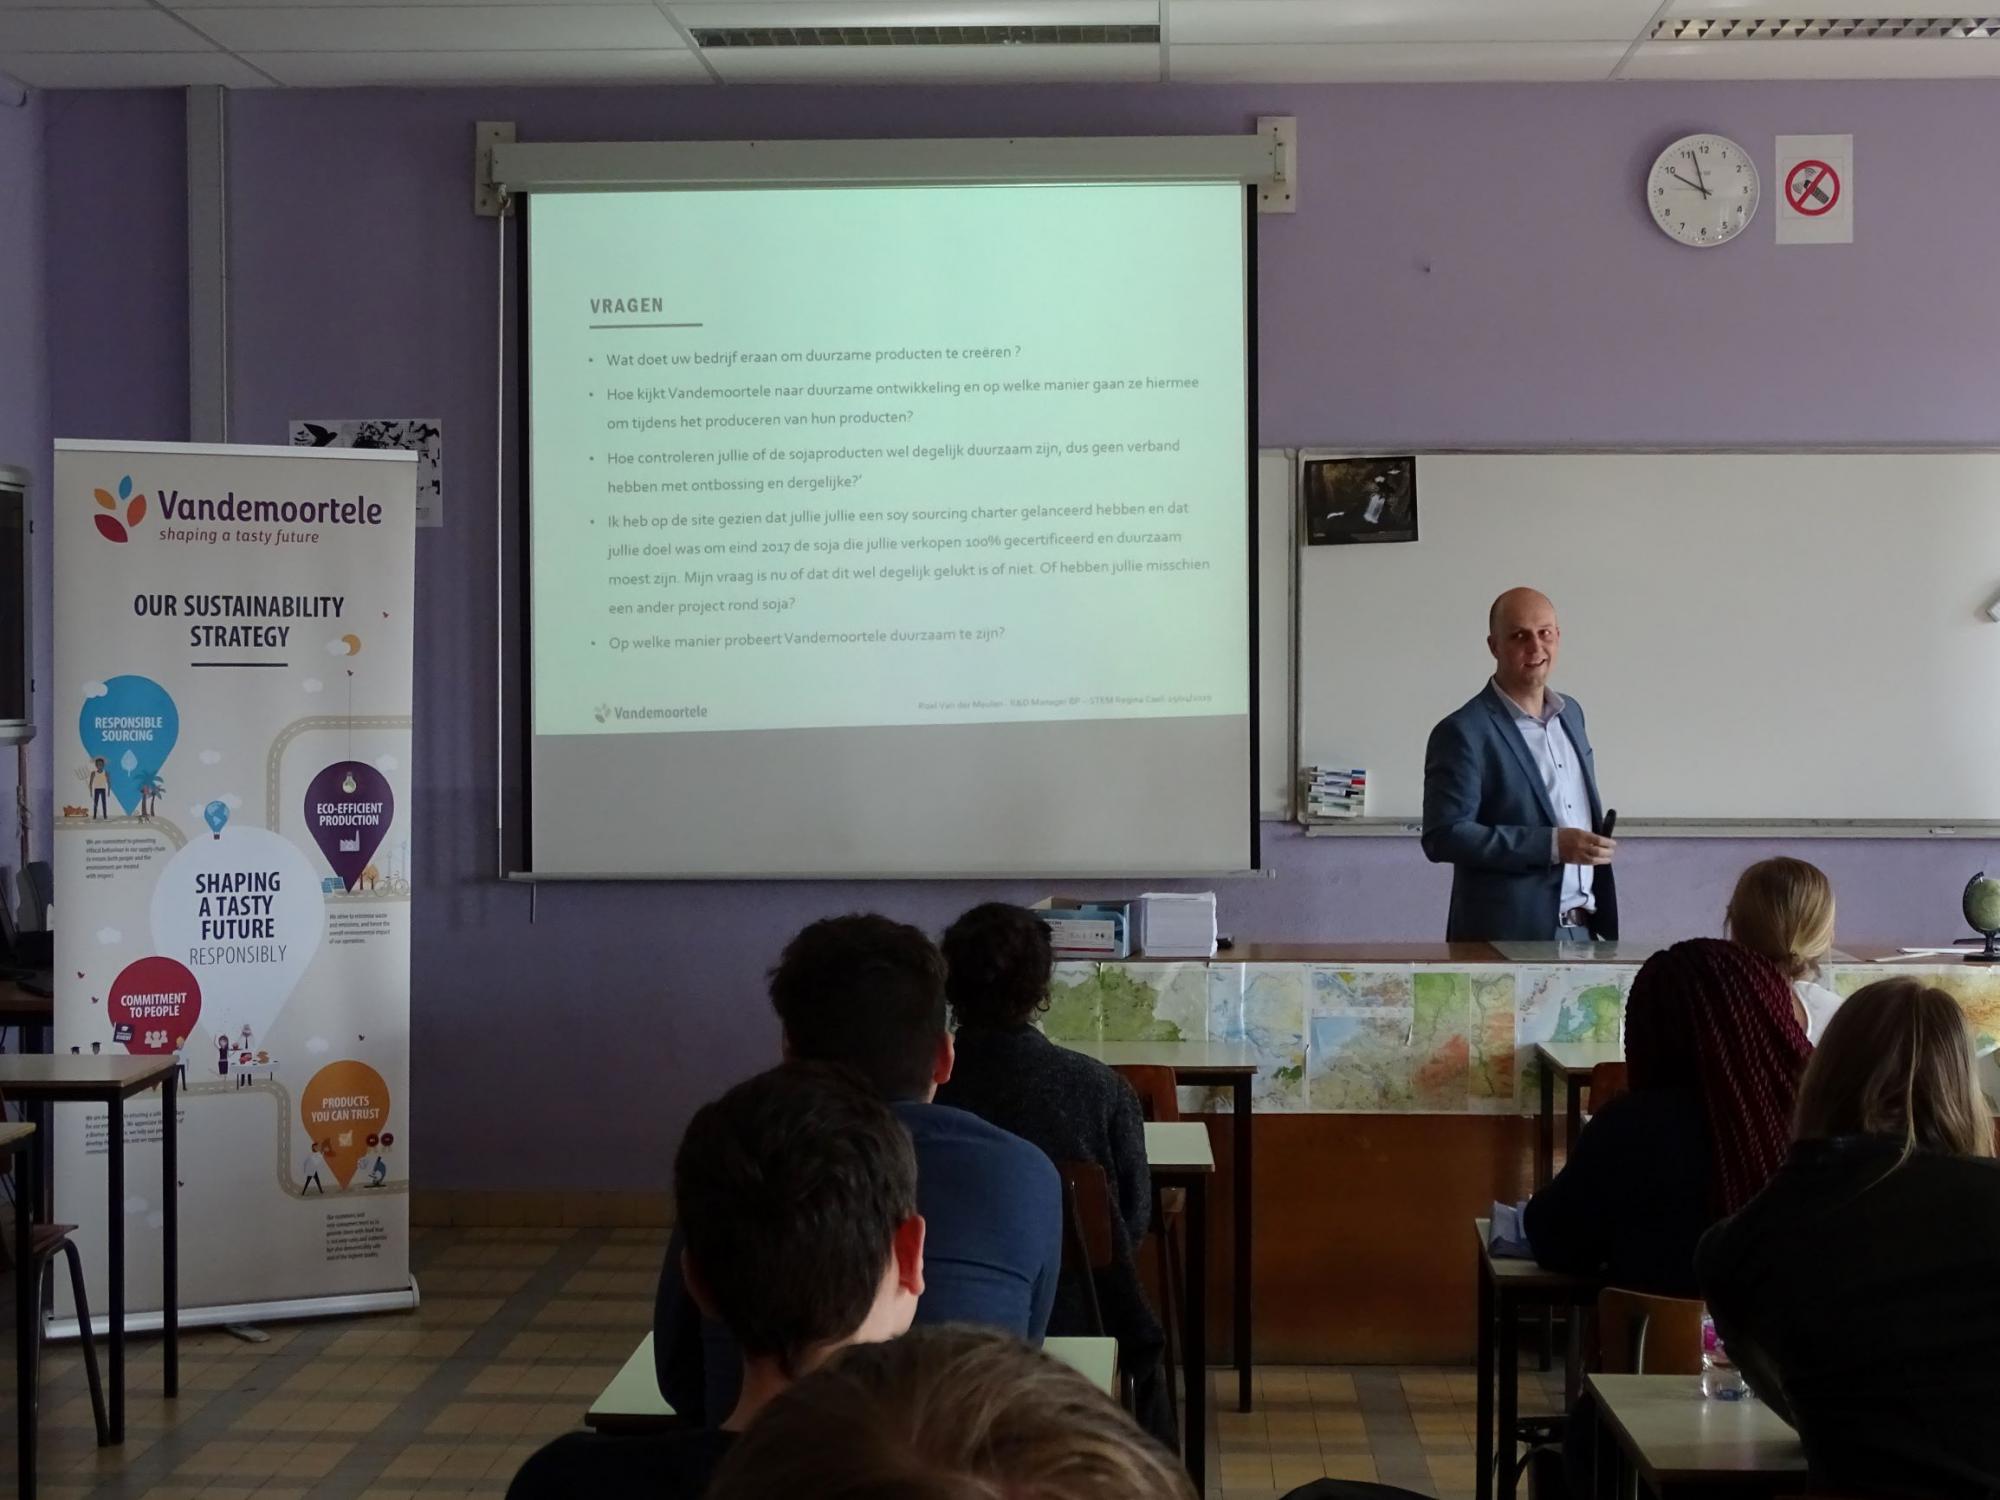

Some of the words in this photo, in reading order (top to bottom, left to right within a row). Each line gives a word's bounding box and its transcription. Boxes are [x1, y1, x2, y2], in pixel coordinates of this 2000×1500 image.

[590, 297, 664, 314] VRAGEN
[605, 352, 634, 366] Wat
[636, 352, 668, 366] doet
[670, 355, 691, 365] uw
[693, 350, 738, 368] bedrijf
[739, 352, 778, 363] eraan
[780, 352, 802, 362] om
[805, 347, 872, 362] duurzame
[874, 346, 942, 363] producten
[944, 348, 958, 359] te
[961, 347, 1011, 359] creëren
[1014, 344, 1021, 357] ?
[606, 387, 634, 401] Hoe
[636, 386, 665, 403] kijkt
[667, 384, 771, 399] Vandemoortele
[774, 386, 804, 397] naar
[806, 382, 873, 396] duurzame
[876, 380, 960, 398] ontwikkeling
[962, 382, 980, 392] en
[982, 382, 1000, 395] op
[1002, 378, 1040, 392] welke
[1043, 380, 1090, 391] manier
[1092, 379, 1124, 393] gaan
[1127, 379, 1143, 389] ze
[1145, 375, 1199, 389] hiermee
[606, 419, 629, 430] om
[631, 415, 677, 432] tijdens
[680, 414, 702, 428] het
[704, 412, 780, 430] produceren
[783, 415, 808, 425] van
[810, 411, 836, 425] hun
[838, 409, 914, 427] producten?
[606, 451, 634, 464] Hoe
[637, 449, 714, 464] controleren
[716, 448, 749, 465] jullie
[752, 447, 766, 461] of
[768, 447, 785, 460] de
[788, 445, 883, 463] sojaproducten
[885, 444, 909, 458] wel
[911, 443, 964, 461] degelijk
[966, 442, 1032, 456] duurzaam
[1035, 441, 1062, 458] zijn,
[1064, 440, 1088, 454] dus
[1091, 442, 1124, 457] geen
[1126, 438, 1180, 452] verband
[606, 479, 658, 493] hebben
[660, 480, 688, 492] met
[690, 477, 764, 495] ontbossing
[766, 479, 784, 489] en
[158, 490, 382, 525] Vandemoortele
[607, 514, 619, 528] Ik
[622, 514, 648, 527] heb
[650, 517, 668, 530] op
[670, 512, 688, 526] de
[690, 513, 714, 526] site
[717, 514, 762, 529] gezien
[764, 510, 787, 523] dat
[788, 509, 821, 526] jullie
[822, 508, 856, 526] jullie
[858, 511, 883, 521] een
[886, 510, 909, 524] soy
[911, 509, 968, 523] sourcing
[970, 505, 1018, 519] charter
[1020, 503, 1093, 521] gelanceerd
[1095, 502, 1145, 515] hebben
[1147, 504, 1164, 514] en
[1166, 500, 1189, 514] dat
[160, 527, 217, 544] shaping
[222, 530, 230, 542] a
[236, 529, 272, 545] tasty
[275, 529, 319, 546] future
[606, 543, 639, 560] jullie
[642, 542, 671, 556] doel
[674, 544, 700, 555] was
[703, 544, 725, 554] om
[728, 539, 757, 553] eind
[761, 542, 790, 555] 2017
[793, 539, 810, 551] de
[813, 541, 840, 554] soja
[842, 536, 863, 550] die
[865, 536, 897, 553] jullie
[900, 534, 961, 552] verkopen
[965, 534, 1001, 548] 100%
[1003, 531, 1094, 550] gecertificeerd
[1096, 534, 1113, 544] en
[1116, 529, 1182, 544] duurzaam
[608, 573, 650, 585] moest
[684, 570, 713, 587] Mijn
[716, 571, 753, 586] vraag
[756, 569, 767, 582] is
[770, 570, 787, 581] nu
[789, 567, 804, 580] of
[806, 566, 828, 580] dat
[830, 566, 849, 579] dit
[852, 565, 876, 578] wel
[878, 563, 930, 582] degelijk
[933, 563, 976, 580] gelukt
[978, 566, 988, 576] is
[990, 562, 1005, 575] of
[1038, 560, 1057, 574] Of
[1059, 559, 1109, 573] hebben
[1110, 558, 1143, 575] jullie
[1145, 557, 1210, 571] misschien
[134, 594, 177, 616] OUR
[184, 595, 344, 618] SUSTAINABILITY
[608, 604, 633, 614] een
[636, 599, 674, 614] ander
[677, 600, 725, 616] project
[727, 598, 759, 611] rond
[761, 596, 796, 613] soja?
[191, 626, 289, 647] STRATEGY
[608, 635, 629, 653] Op
[631, 634, 671, 649] welke
[674, 634, 720, 648] manier
[724, 632, 782, 649] probeert
[783, 629, 887, 644] Vandemoortele
[889, 627, 956, 641] duurzaam
[958, 628, 972, 640] te
[975, 625, 1006, 642] zijn?
[95, 716, 163, 730] RESPONSIBLE
[614, 706, 708, 721] Vandemoortele
[102, 729, 153, 742] SOURCING
[317, 802, 383, 816] ECO-EFFICIENT
[319, 814, 379, 827] PRODUCTION
[195, 871, 281, 894] SHAPING
[199, 896, 214, 917] A
[217, 894, 274, 916] TASTY
[201, 918, 275, 940] FUTURE
[190, 945, 287, 966] RESPONSIBLY
[121, 992, 187, 1007] COMMITMENT
[130, 1005, 142, 1018] TO
[144, 1004, 180, 1018] PEOPLE
[322, 1096, 370, 1108] PRODUCTS
[311, 1110, 329, 1122] YOU
[331, 1109, 349, 1121] CAN
[351, 1108, 380, 1121] TRUST
